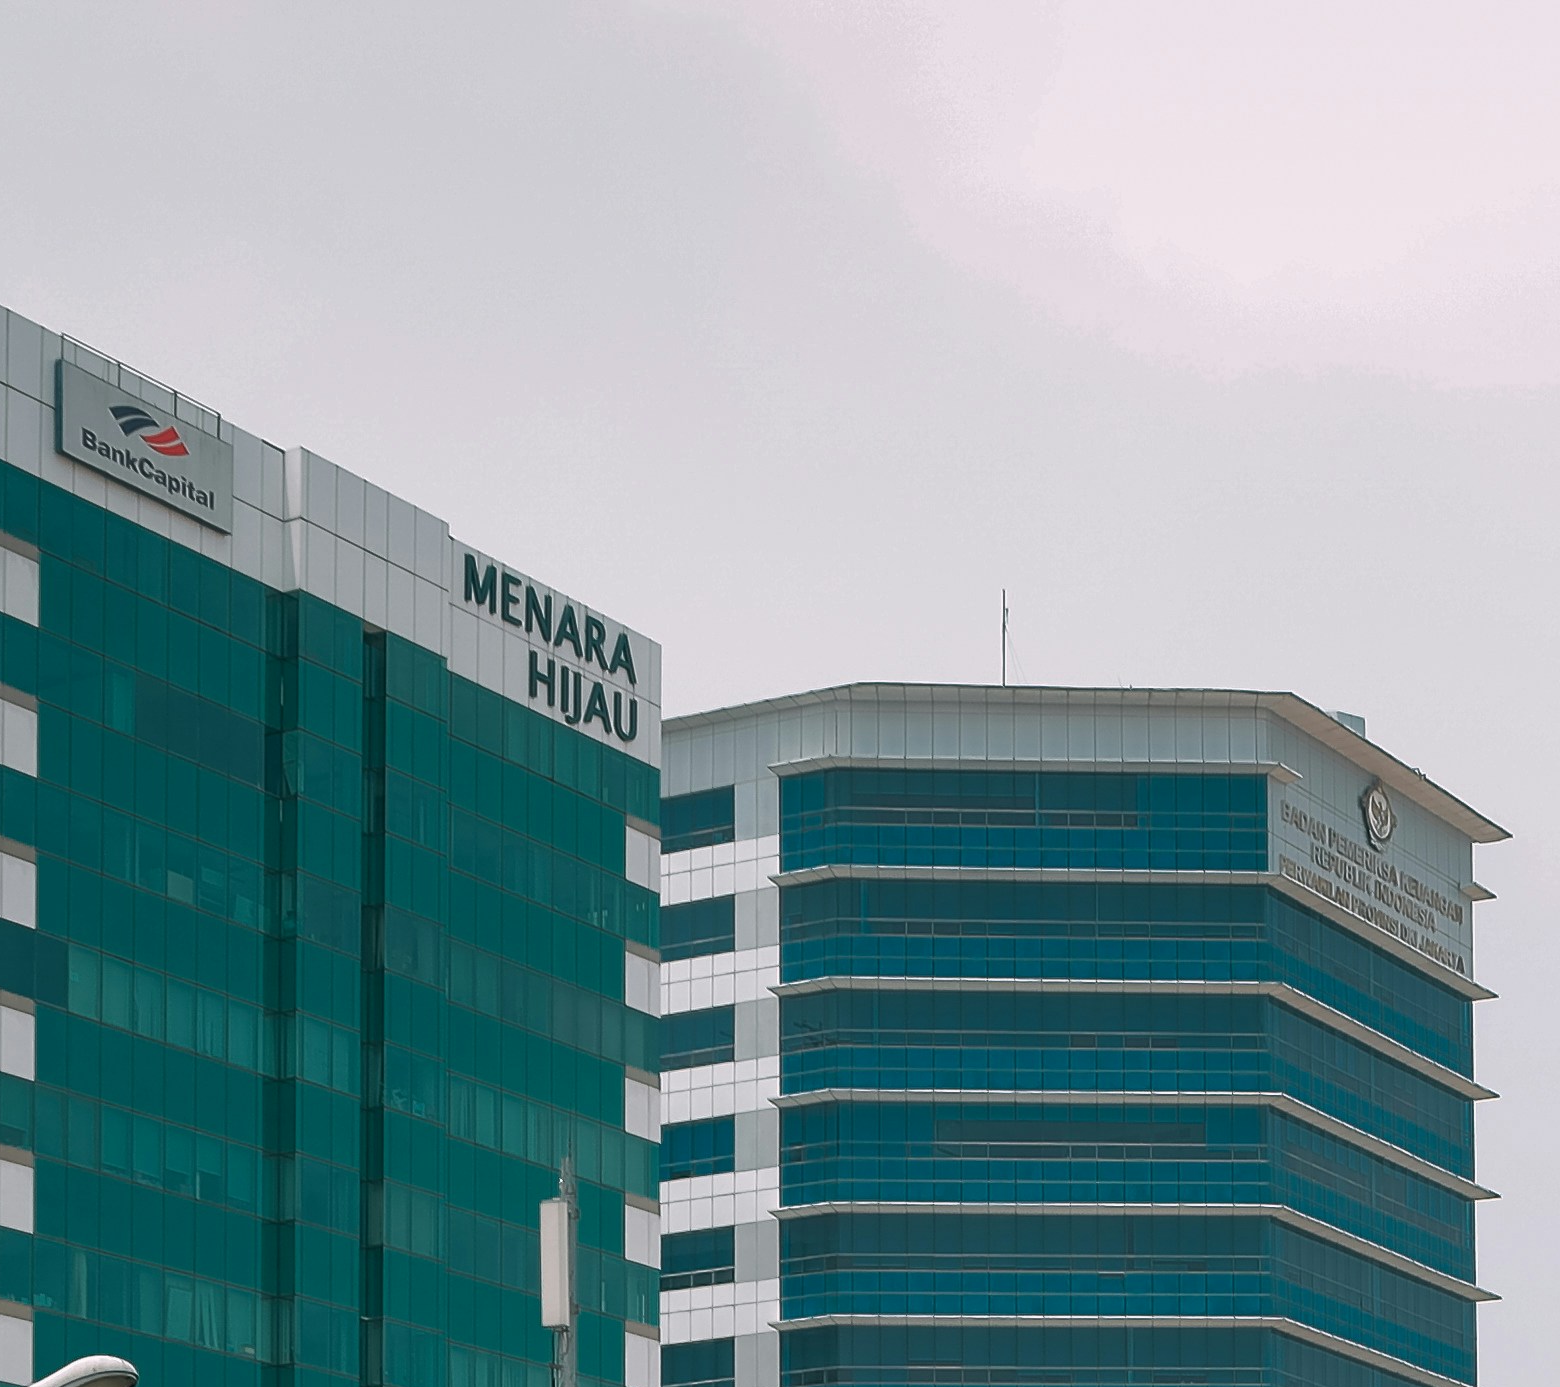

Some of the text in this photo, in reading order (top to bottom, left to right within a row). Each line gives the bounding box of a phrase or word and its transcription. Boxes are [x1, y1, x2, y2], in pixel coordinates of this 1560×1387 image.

[80, 427, 216, 512] BankCapital
[462, 552, 640, 686] MENARA
[528, 649, 639, 743] HIJAU
[1281, 800, 1464, 926] BADAN PEMERIKSA KEUANGAN
[1311, 842, 1438, 934] REPUBLIK INDONESIA
